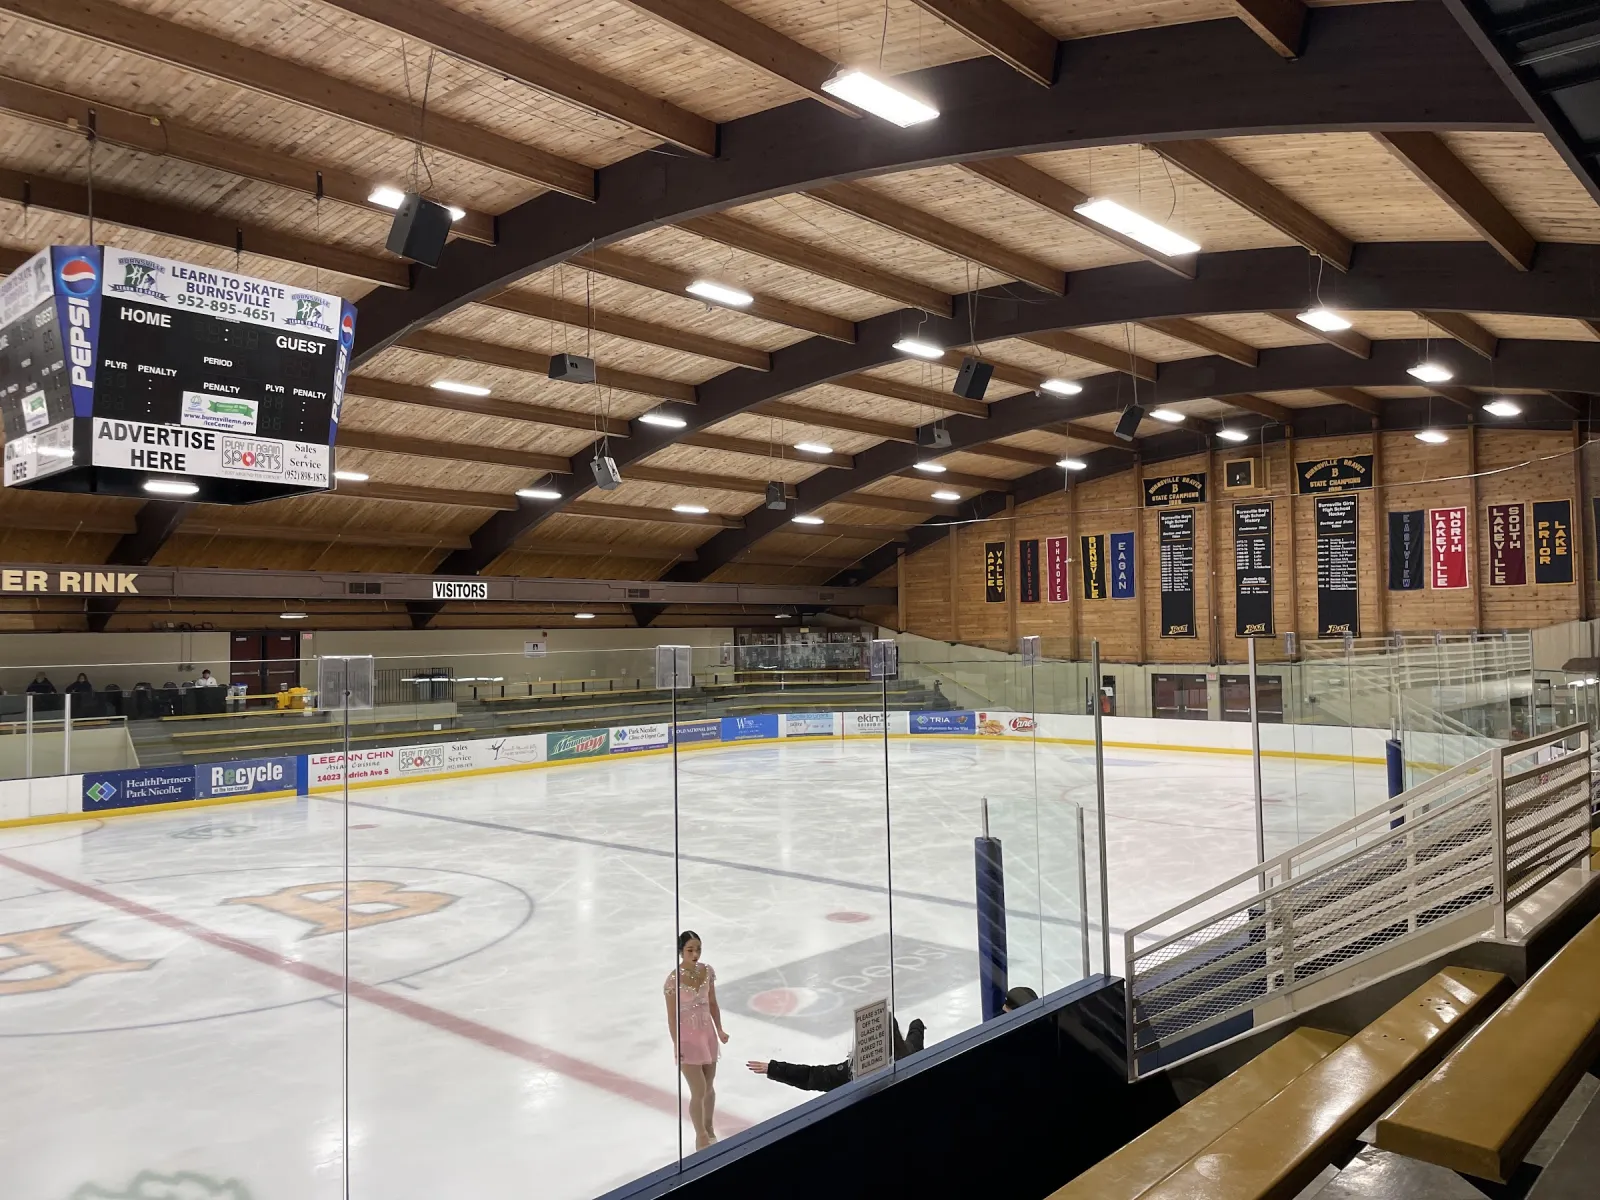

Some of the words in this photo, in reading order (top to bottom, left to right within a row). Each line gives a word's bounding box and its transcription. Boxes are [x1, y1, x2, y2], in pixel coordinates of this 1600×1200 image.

[118, 258, 166, 274] BURNSVILLE
[172, 266, 218, 286] LEARN
[222, 276, 240, 290] TO
[244, 282, 285, 300] SKATE
[186, 282, 270, 308] BURNSVILLE
[291, 293, 331, 308] BURNSVILLE
[177, 294, 276, 322] 952-895-4651
[120, 306, 172, 328] HOME
[68, 296, 94, 388] PEPSI
[276, 336, 326, 355] GUEST
[105, 360, 128, 370] PLYR
[138, 364, 178, 377] PENALTY
[204, 356, 232, 368] PERIOD
[203, 382, 240, 394] PENALTY
[331, 344, 348, 424] PEPSI
[266, 384, 285, 394] PLYR
[293, 388, 327, 400] PENALTY
[184, 413, 254, 426] www.burnsvillemn.gov
[98, 422, 216, 450] ADVERTISE
[225, 440, 244, 450] PLAY
[246, 442, 254, 451] IT
[256, 444, 280, 454] AGAIN
[294, 444, 316, 454] Sales
[130, 449, 186, 472] HERE
[224, 450, 281, 470] SPORTS
[290, 458, 321, 469] Service
[284, 470, 300, 480] (952)
[300, 472, 327, 482] 898-1878
[1304, 460, 1338, 479] BURNSVILLE
[1344, 459, 1366, 474] BRAVES
[1332, 468, 1339, 477] B
[1148, 477, 1180, 494] BURNSVILLE
[1182, 477, 1202, 489] BRAVES
[1172, 484, 1179, 493] B
[1329, 477, 1360, 486] CHAMPIONS
[1435, 512, 1448, 586] LAKEVILLE
[1450, 511, 1461, 553] NORTH
[1493, 508, 1506, 583] LAKEVILLE
[1508, 506, 1521, 549] SOUTH
[1538, 522, 1551, 565] PRIOR
[1555, 520, 1567, 555] LAKE
[1402, 515, 1410, 588] EASTVIEW
[1089, 537, 1099, 599] BURNSVILLE
[1118, 542, 1126, 590] EAGAN
[60, 571, 139, 594] RINK
[435, 583, 486, 598] VISITORS
[557, 736, 593, 752] Mountain
[367, 750, 394, 760] CHIN
[401, 755, 443, 769] SPORTS
[126, 776, 192, 788] HealthPartners
[212, 762, 283, 790] Recycle
[317, 773, 341, 782] 14023
[343, 771, 368, 780] drich
[126, 787, 147, 799] Park
[148, 786, 182, 796] Nicollet
[857, 1012, 873, 1023] PLEASE
[874, 1008, 885, 1016] STAY
[862, 1020, 871, 1028] OFF
[872, 1017, 880, 1025] THE
[860, 1027, 875, 1037] GLASS
[858, 1038, 867, 1046] YOU
[868, 1034, 878, 1042] WILL
[860, 1051, 874, 1062] LEAVE
[875, 1047, 883, 1055] THE
[861, 1043, 875, 1053] ASKED
[862, 1056, 882, 1069] BUILDING
